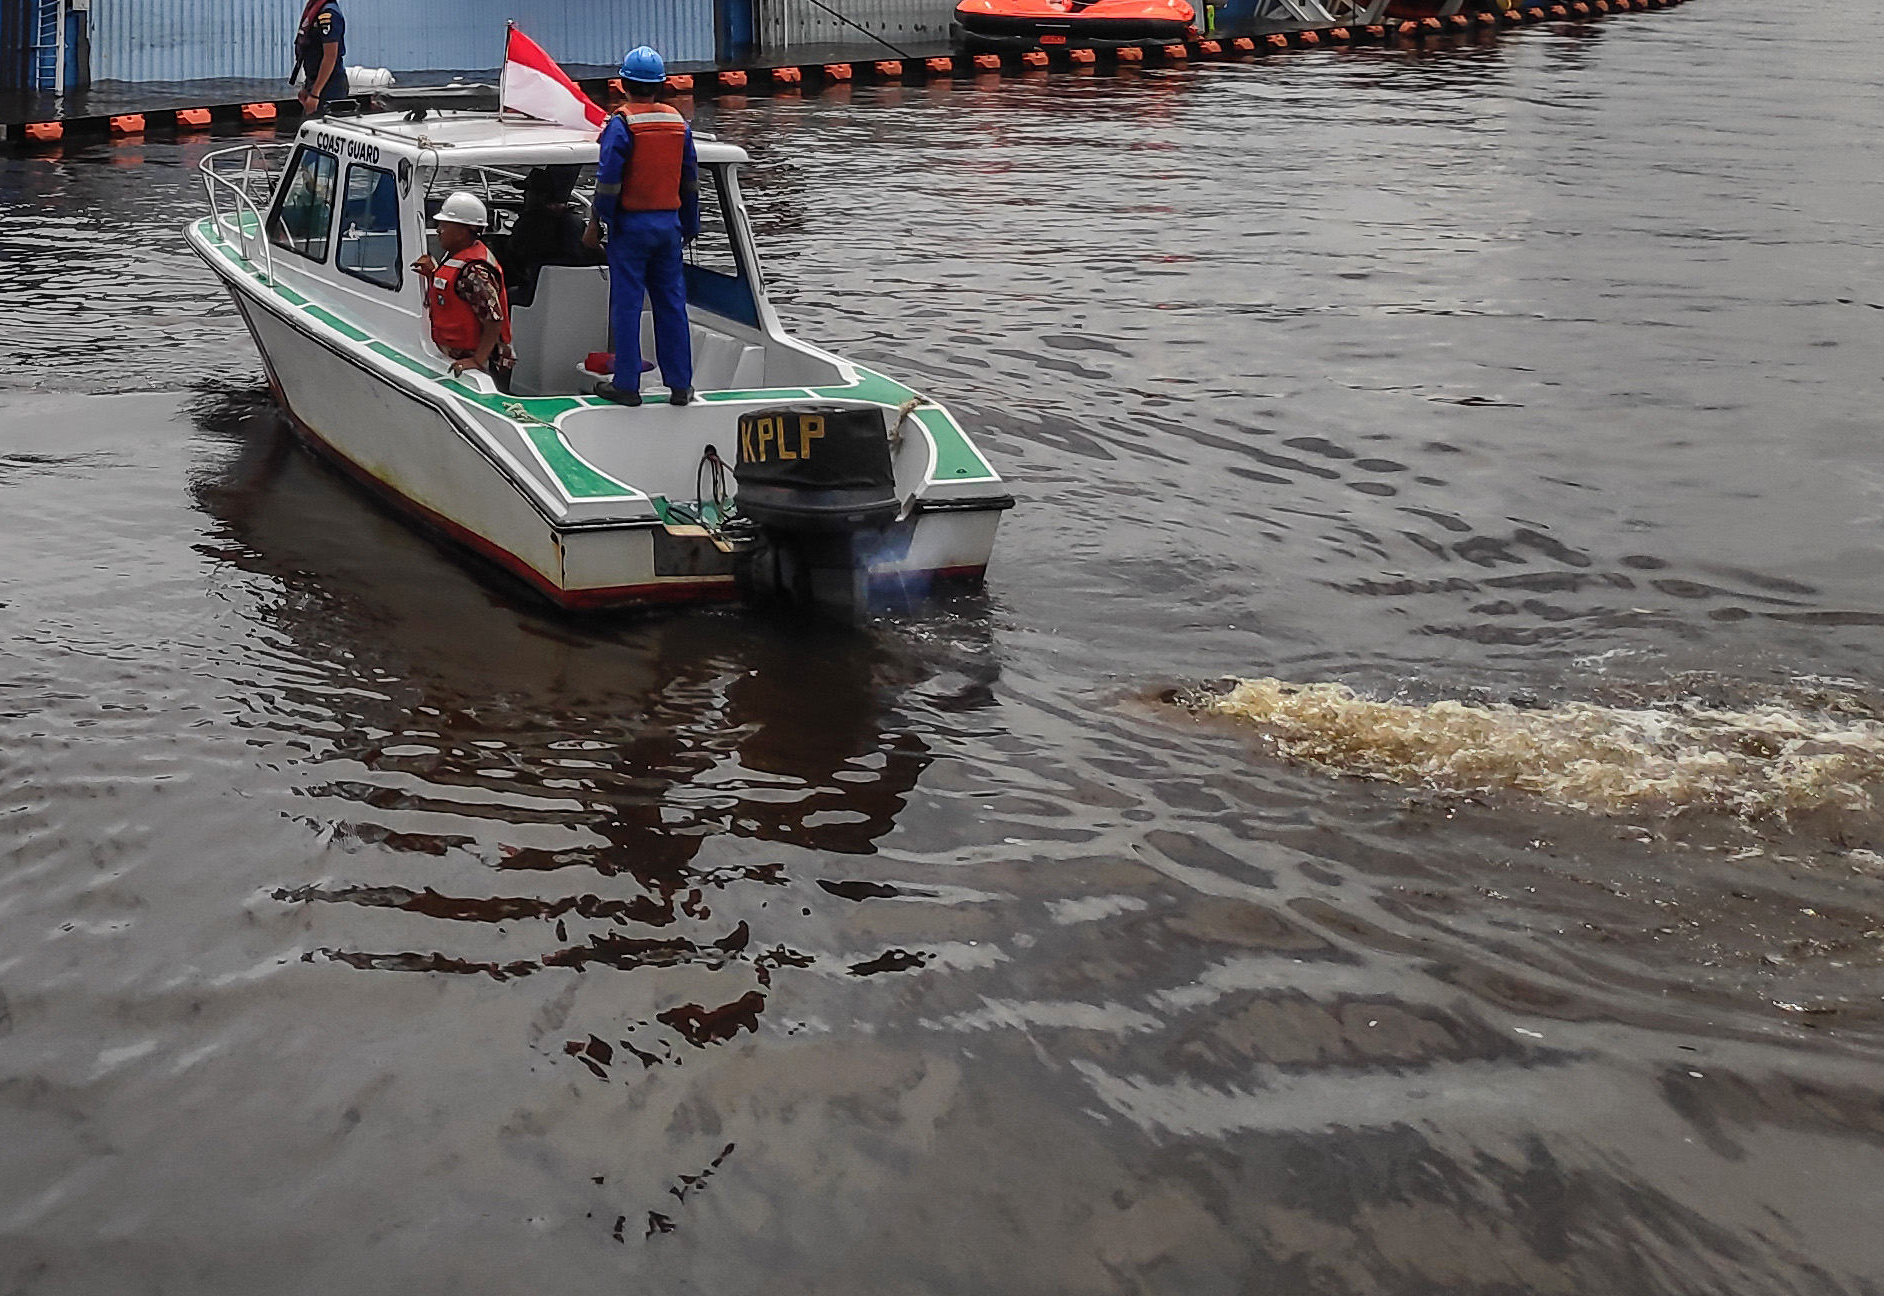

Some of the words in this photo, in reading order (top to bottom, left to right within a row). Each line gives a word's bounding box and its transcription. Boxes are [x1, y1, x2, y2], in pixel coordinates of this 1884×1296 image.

[317, 132, 346, 155] COAST
[347, 140, 380, 164] GUARD
[741, 415, 825, 463] KPLP
